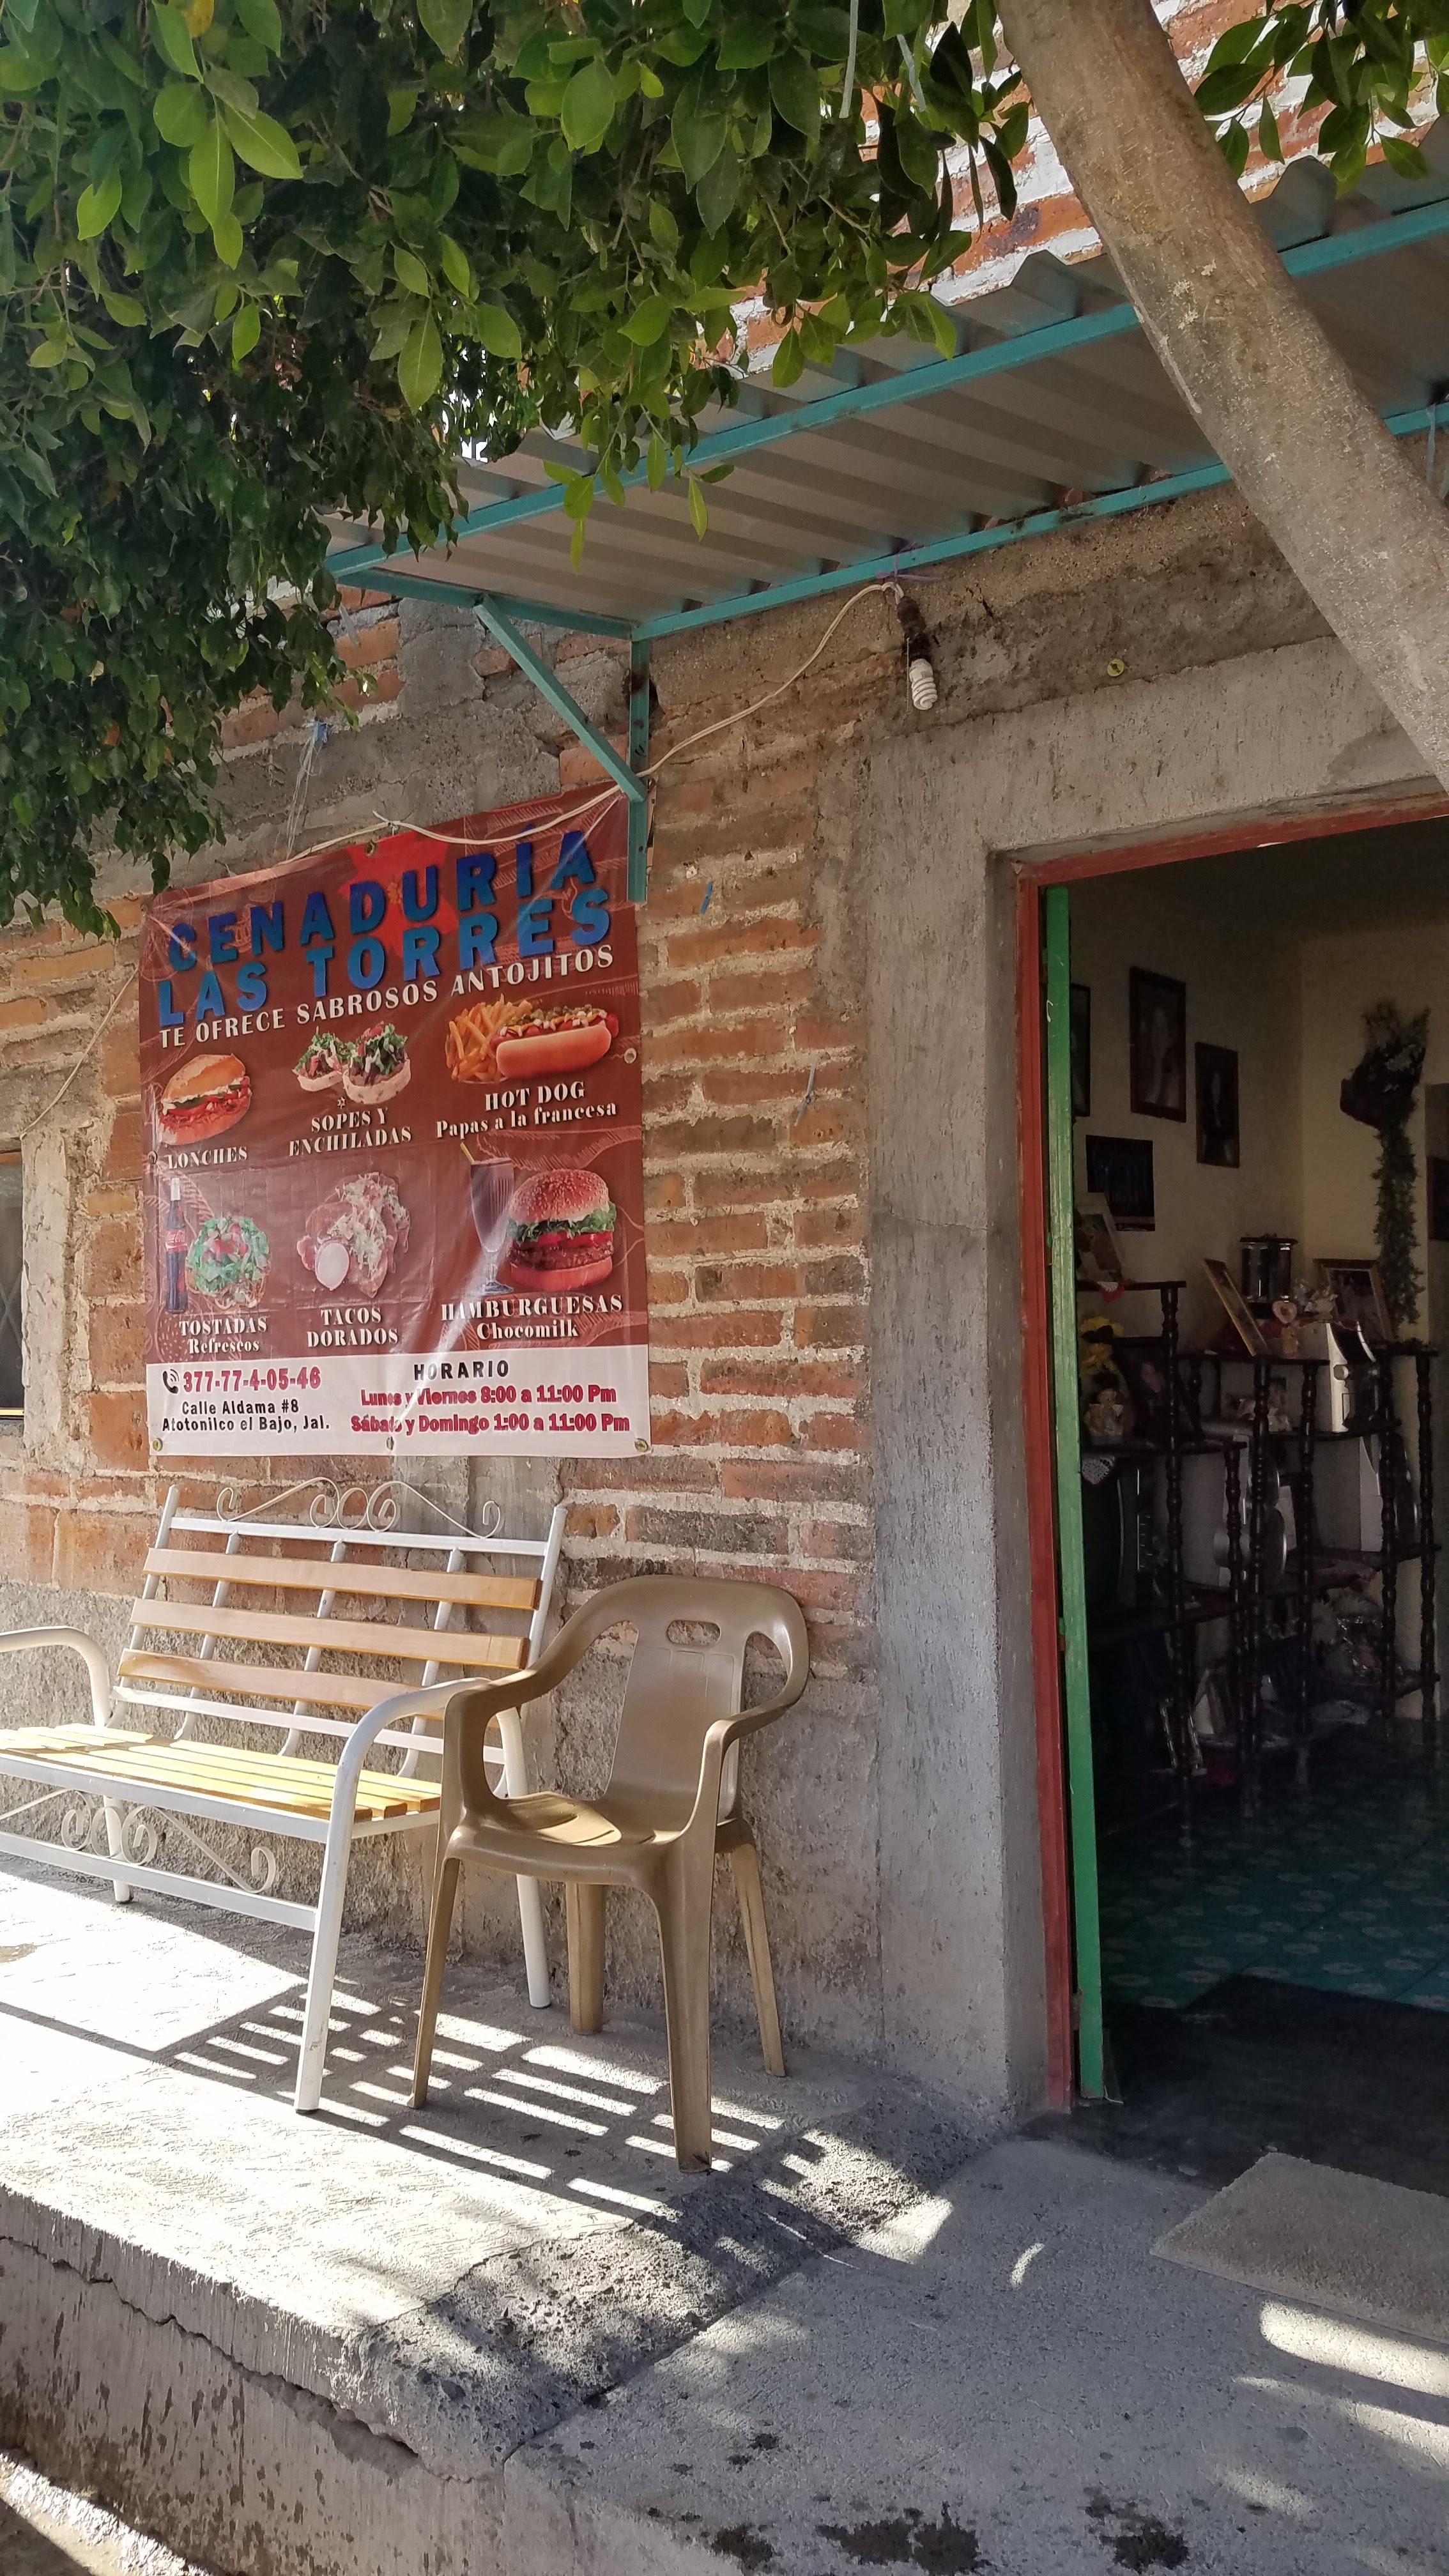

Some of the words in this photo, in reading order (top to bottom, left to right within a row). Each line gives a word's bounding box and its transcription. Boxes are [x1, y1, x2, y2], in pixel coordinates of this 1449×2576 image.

[160, 962, 267, 1026] LAS
[306, 887, 611, 998] TORRES
[160, 1027, 185, 1048] TE
[195, 1008, 286, 1043] OFRECE
[296, 981, 438, 1025] SABROSOS
[450, 944, 614, 997] ANTOJITOS
[485, 1087, 530, 1112] HOT
[537, 1080, 585, 1105] DOG
[310, 1110, 371, 1133] SOPES
[377, 1107, 388, 1125] Y
[436, 1117, 488, 1140] Papas
[494, 1117, 504, 1130] a
[511, 1110, 527, 1128] la
[534, 1101, 617, 1125] francesa
[289, 1126, 412, 1157] ENCHILADAS
[167, 1146, 249, 1170] LONCHES
[321, 1307, 382, 1326] TACOS
[441, 1294, 623, 1321] HAMBURGUESAS
[179, 1316, 268, 1337] TOSTADAS
[307, 1328, 399, 1348] DORADOS
[477, 1319, 578, 1340] Chocomilk
[188, 1337, 260, 1354] Refrescos
[183, 1366, 321, 1393] 377-77-4-05-46
[414, 1360, 509, 1381] HORARIO
[182, 1401, 217, 1414] Calle
[222, 1400, 275, 1414] Aldama
[282, 1399, 299, 1413] #8
[361, 1389, 402, 1406] Lunes
[418, 1388, 477, 1405] Viernes
[480, 1386, 516, 1404] 8:00
[521, 1388, 532, 1403] a
[537, 1384, 583, 1402] 11:00
[588, 1384, 617, 1402] Pm
[162, 1416, 234, 1432] Atotonilco
[240, 1416, 252, 1430] el
[259, 1416, 298, 1434] Bajo,
[303, 1415, 330, 1430] Jal.
[351, 1414, 402, 1432] Sábado
[404, 1419, 415, 1436] y
[418, 1414, 489, 1434] Domingo
[494, 1413, 530, 1431] 1:00
[533, 1416, 544, 1432] a
[549, 1413, 597, 1431] 11:00
[601, 1413, 630, 1432] Pm
